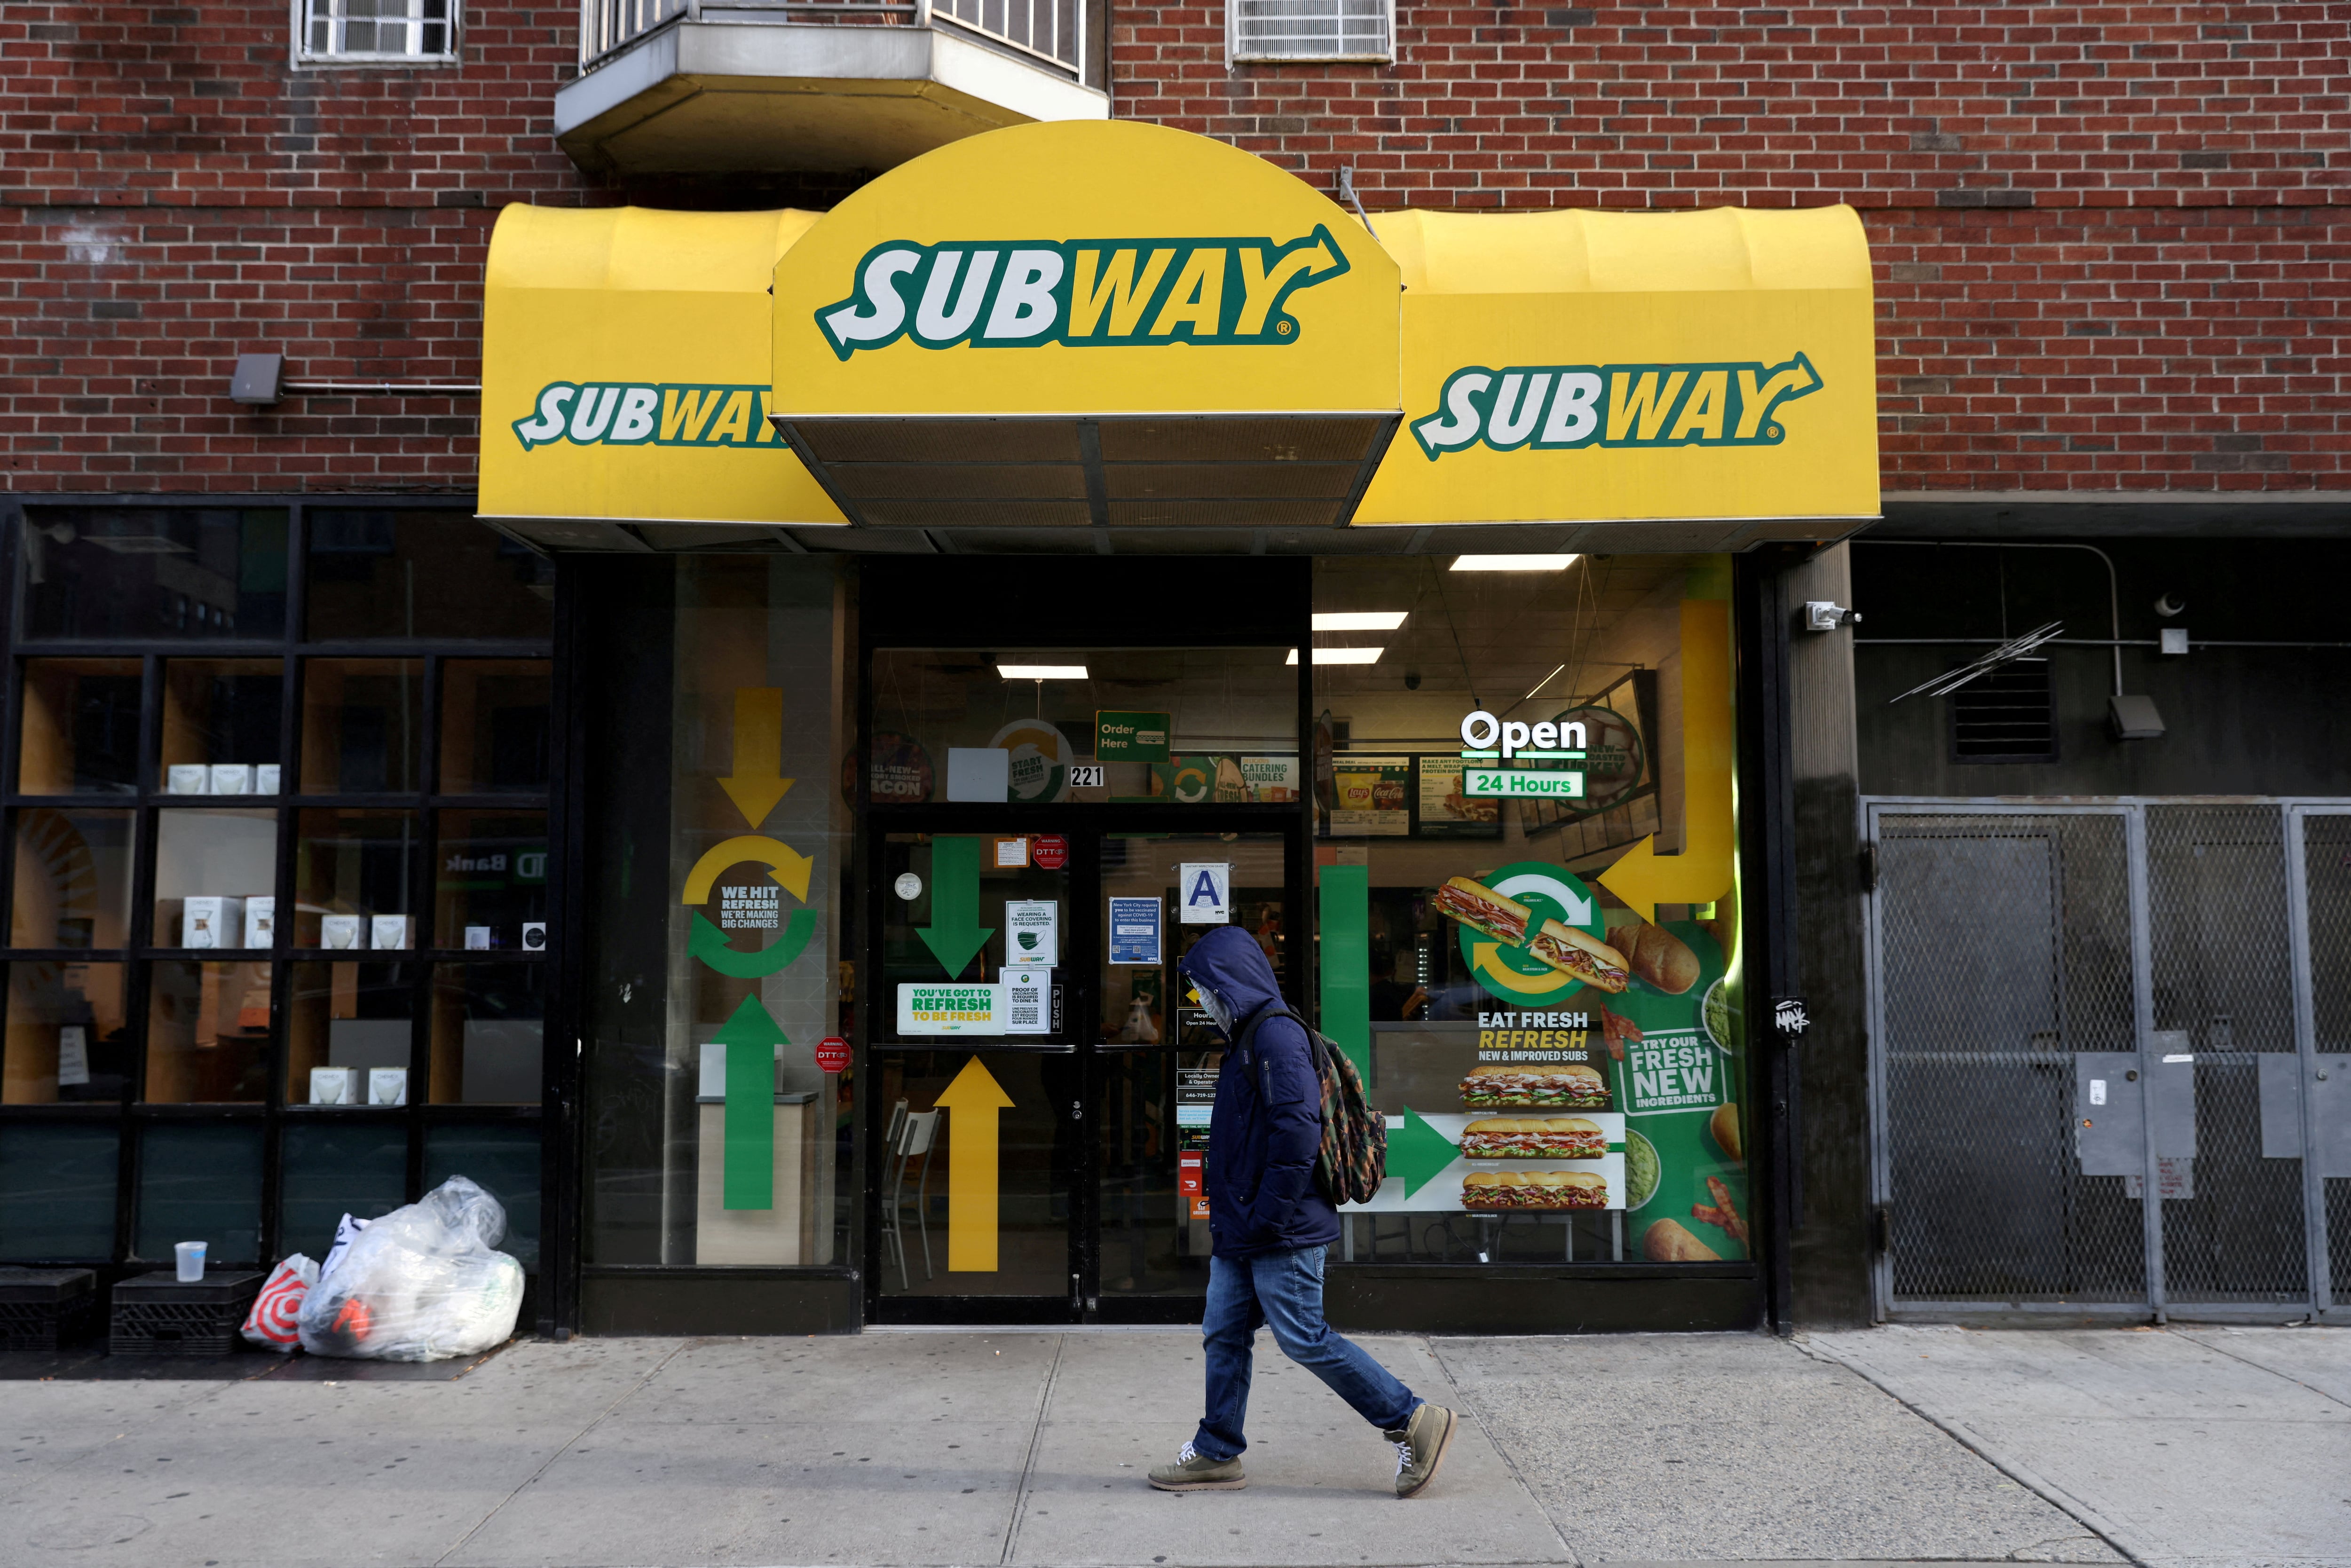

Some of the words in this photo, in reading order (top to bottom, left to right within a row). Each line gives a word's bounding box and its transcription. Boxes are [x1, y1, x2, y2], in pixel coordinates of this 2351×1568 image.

[825, 236, 1336, 347] SUBWAY
[1418, 361, 1814, 450] SUBWAY
[1101, 724, 1134, 734] Order
[1460, 710, 1586, 758] Open
[1101, 738, 1128, 749] Here
[1011, 756, 1041, 769] START
[1243, 764, 1287, 772] CATERING
[1013, 764, 1043, 778] FRESH
[1072, 767, 1100, 786] 221
[871, 780, 920, 796] ACON
[1477, 775, 1503, 793] 24
[1510, 775, 1571, 793] Hours
[722, 887, 748, 898] WE
[750, 887, 779, 898] HIT
[1188, 871, 1221, 906] A
[722, 900, 779, 909] REFRESH
[721, 910, 745, 919] WE'RE
[747, 910, 778, 919] MAKING
[722, 920, 736, 928] BIG
[738, 920, 778, 928] CHANGES
[912, 998, 991, 1010] REFRESH
[912, 1012, 930, 1021] TO
[932, 1012, 948, 1021] BE
[950, 1012, 991, 1021] FRESH
[1478, 1012, 1516, 1028] EAT
[1522, 1012, 1587, 1028] FRESH
[1479, 1031, 1587, 1048] REFRESH
[1641, 1038, 1668, 1050] TRY
[1669, 1036, 1698, 1048] OUR
[1479, 1051, 1500, 1061] NEW
[1501, 1051, 1509, 1061] &
[1511, 1051, 1561, 1061] IMPROVED
[1562, 1051, 1588, 1061] SUBS
[1631, 1047, 1712, 1072] FRESH
[1633, 1066, 1712, 1098] NEW
[1636, 1094, 1716, 1108] INGREDIENTS
